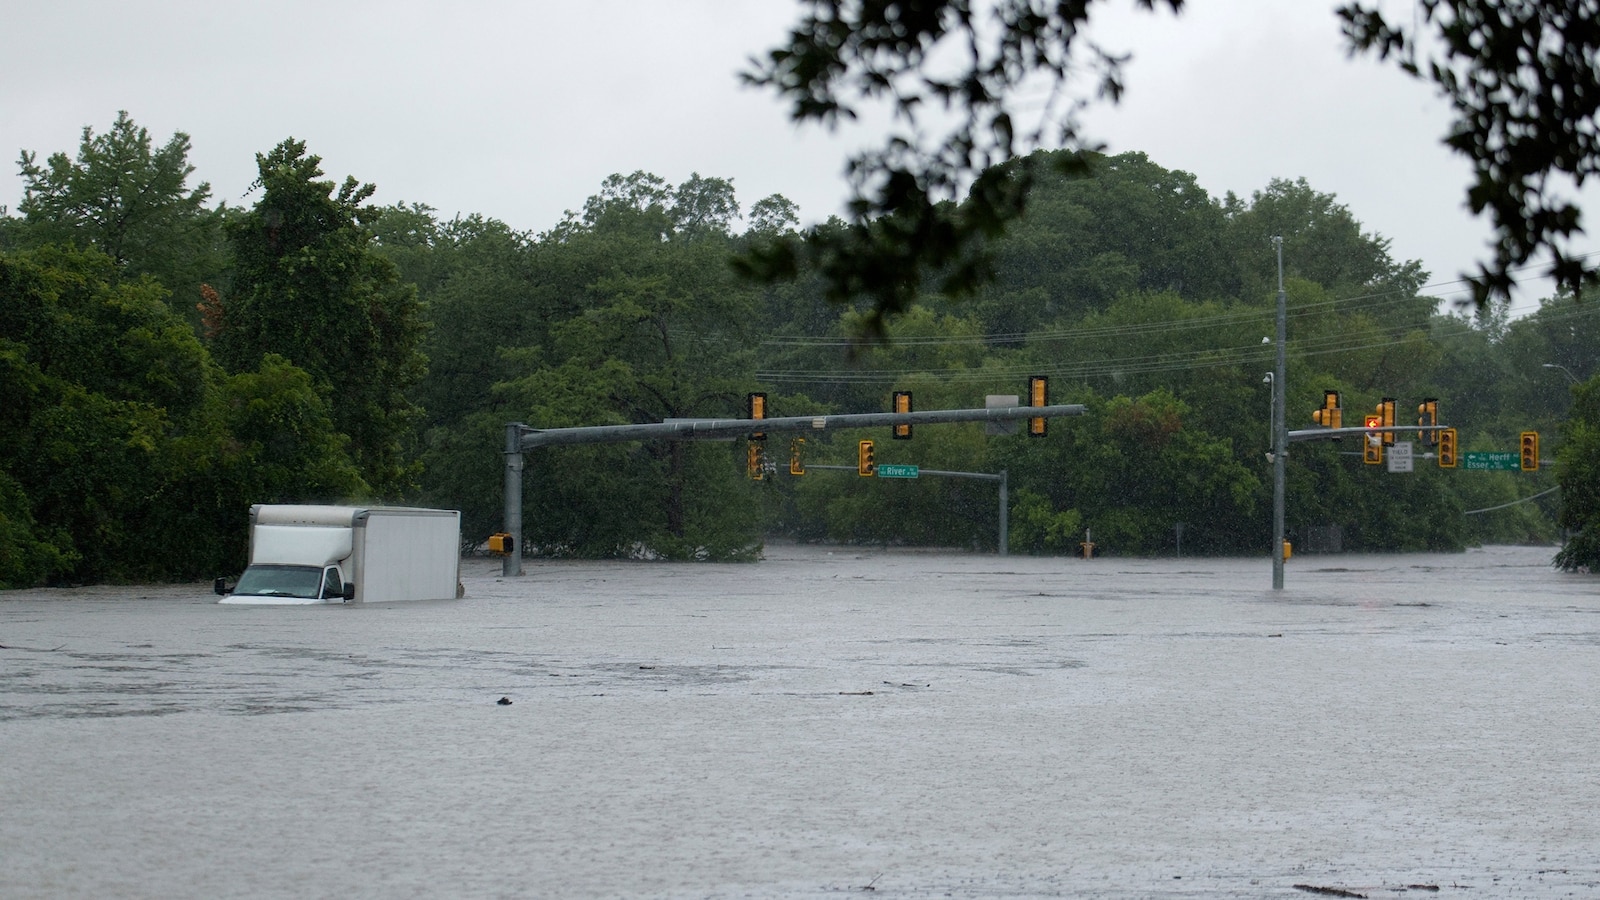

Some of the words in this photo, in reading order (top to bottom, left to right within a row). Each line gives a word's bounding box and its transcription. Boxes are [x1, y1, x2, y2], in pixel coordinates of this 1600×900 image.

[1489, 453, 1510, 461] Herff
[1467, 461, 1489, 469] Esser
[887, 466, 906, 475] River
